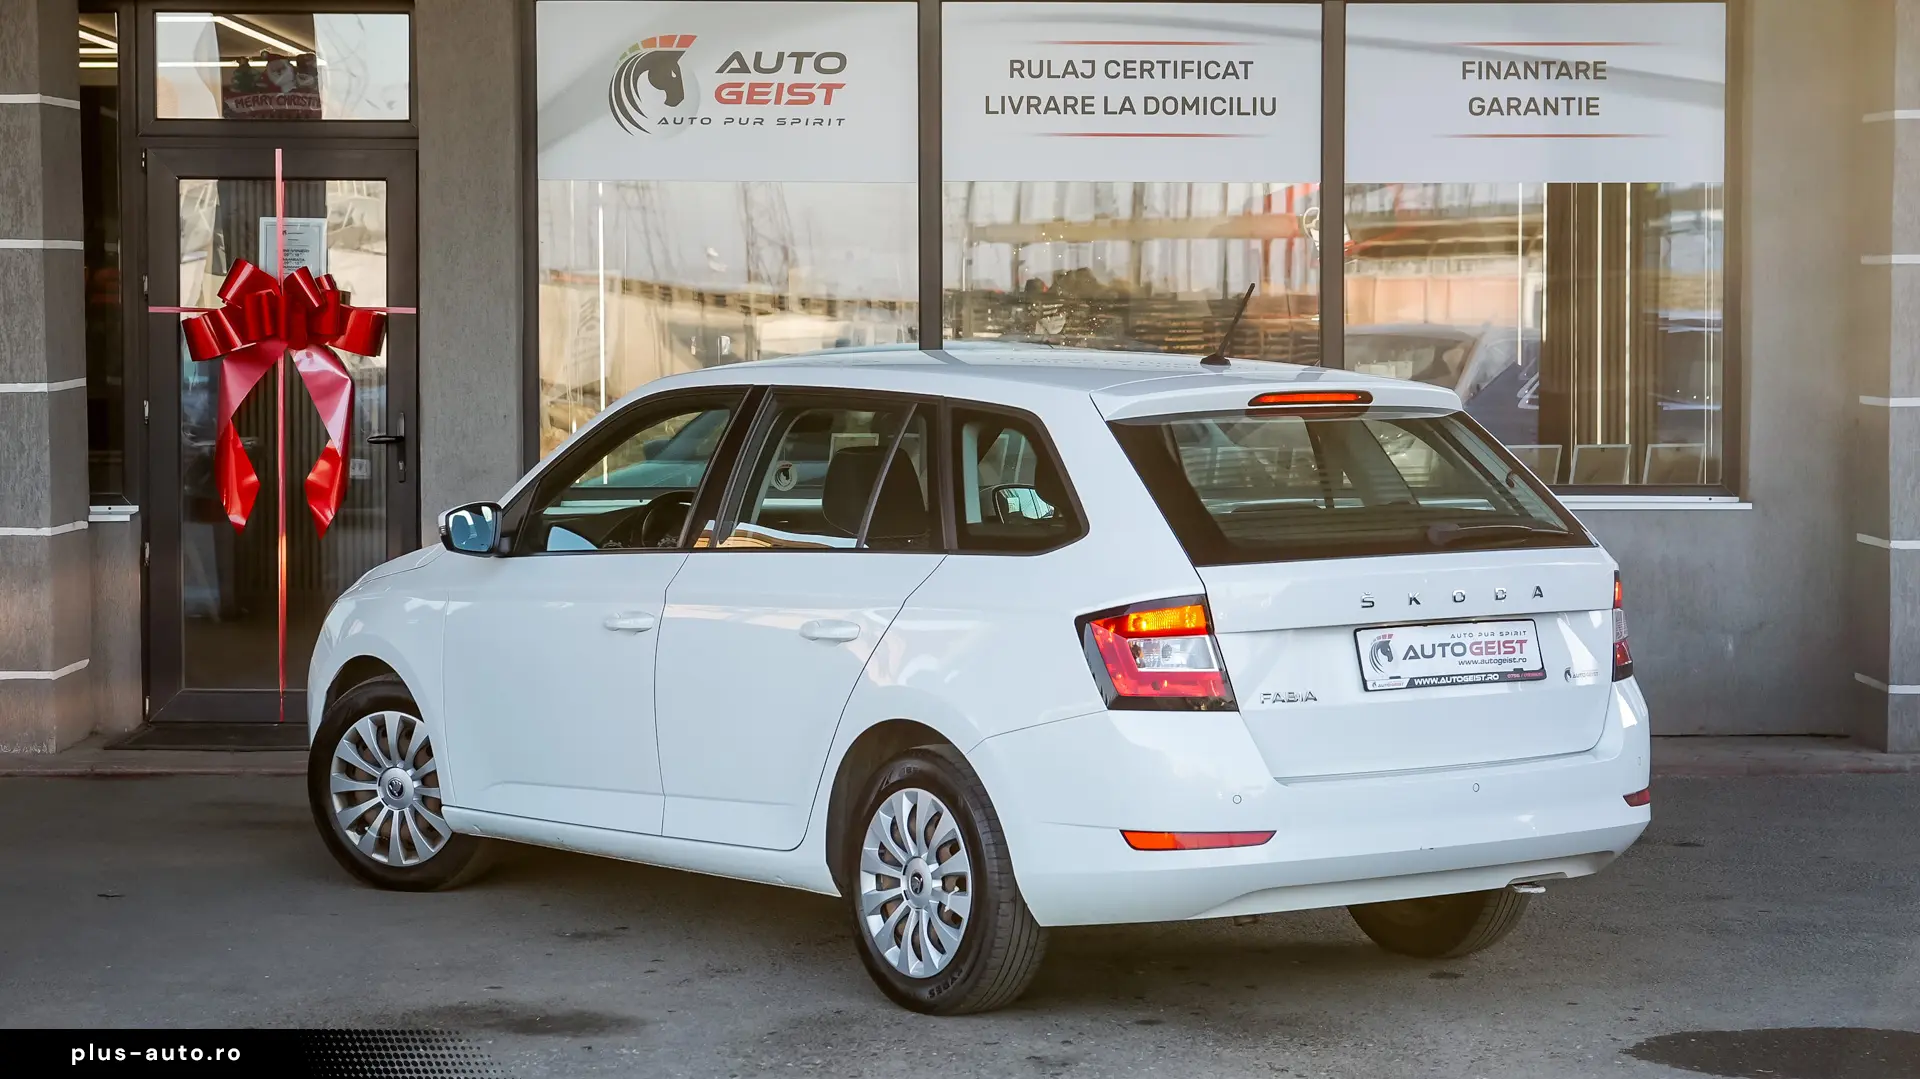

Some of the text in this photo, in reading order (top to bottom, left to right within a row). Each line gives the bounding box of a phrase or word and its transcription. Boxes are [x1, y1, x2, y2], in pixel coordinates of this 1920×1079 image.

[714, 50, 848, 75] AUTO
[1009, 59, 1254, 80] RULAJ CERTIFICAT
[1461, 60, 1608, 80] FINANTARE
[233, 94, 273, 109] MERRY
[714, 82, 847, 106] GEIST
[984, 95, 1277, 116] LIVRARE LA DOMICILIU
[1468, 96, 1601, 117] GARANTIE
[657, 117, 846, 127] AUTO PUR SPIRIT
[1458, 656, 1528, 666] www.autogeist.ro
[1413, 673, 1500, 686] WWW.AUTOGEIST.RO
[1260, 690, 1318, 704] FABIA
